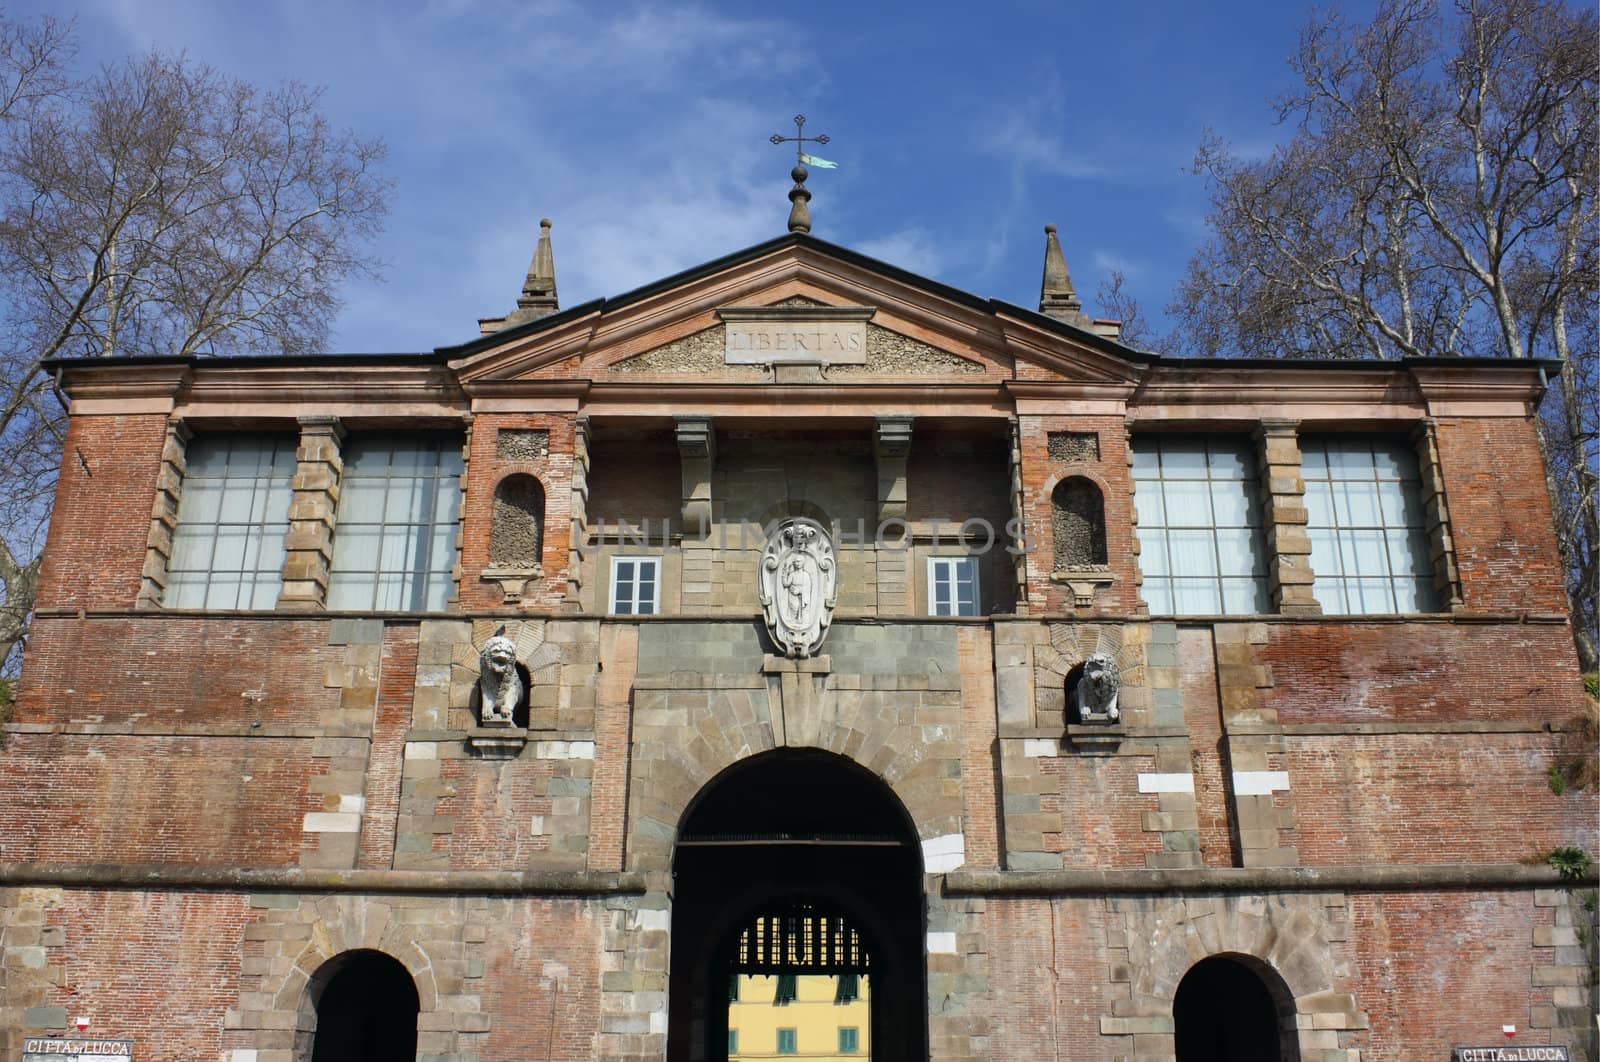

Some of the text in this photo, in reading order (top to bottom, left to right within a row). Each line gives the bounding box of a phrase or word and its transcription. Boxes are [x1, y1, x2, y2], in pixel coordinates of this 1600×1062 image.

[730, 332, 861, 351] LIBERTAS
[84, 1041, 129, 1055] LUCCA
[1518, 1048, 1565, 1061] LUCCA
